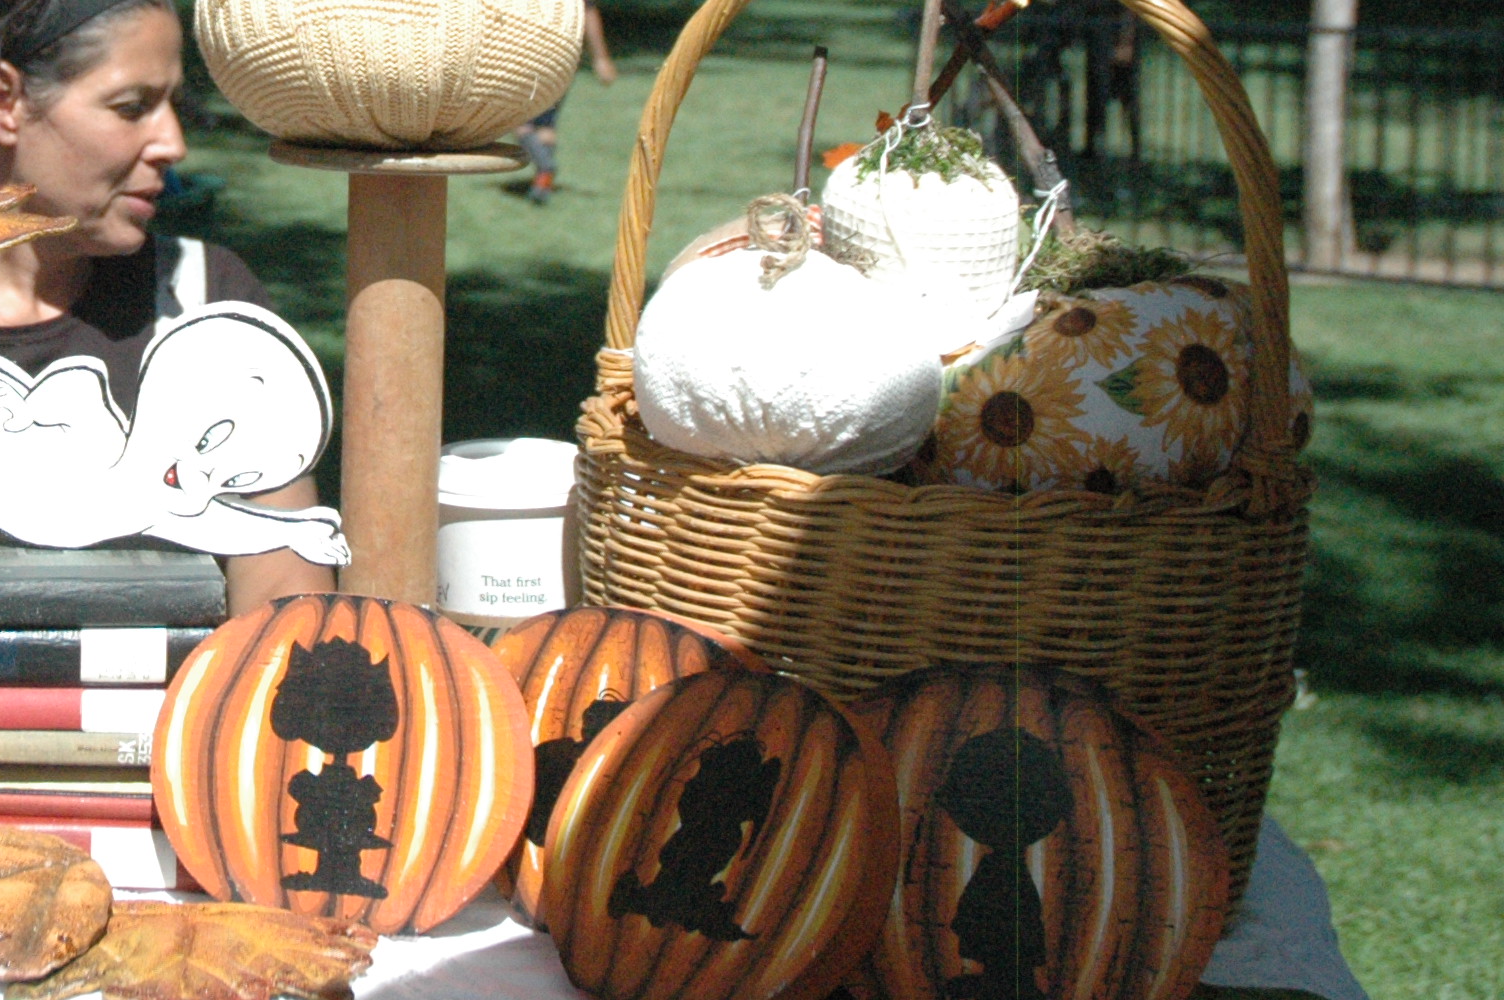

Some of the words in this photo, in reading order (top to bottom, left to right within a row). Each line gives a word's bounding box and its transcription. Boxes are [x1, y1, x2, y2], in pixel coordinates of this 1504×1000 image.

[481, 575, 511, 588] That
[516, 576, 541, 588] first
[479, 592, 498, 605] sip
